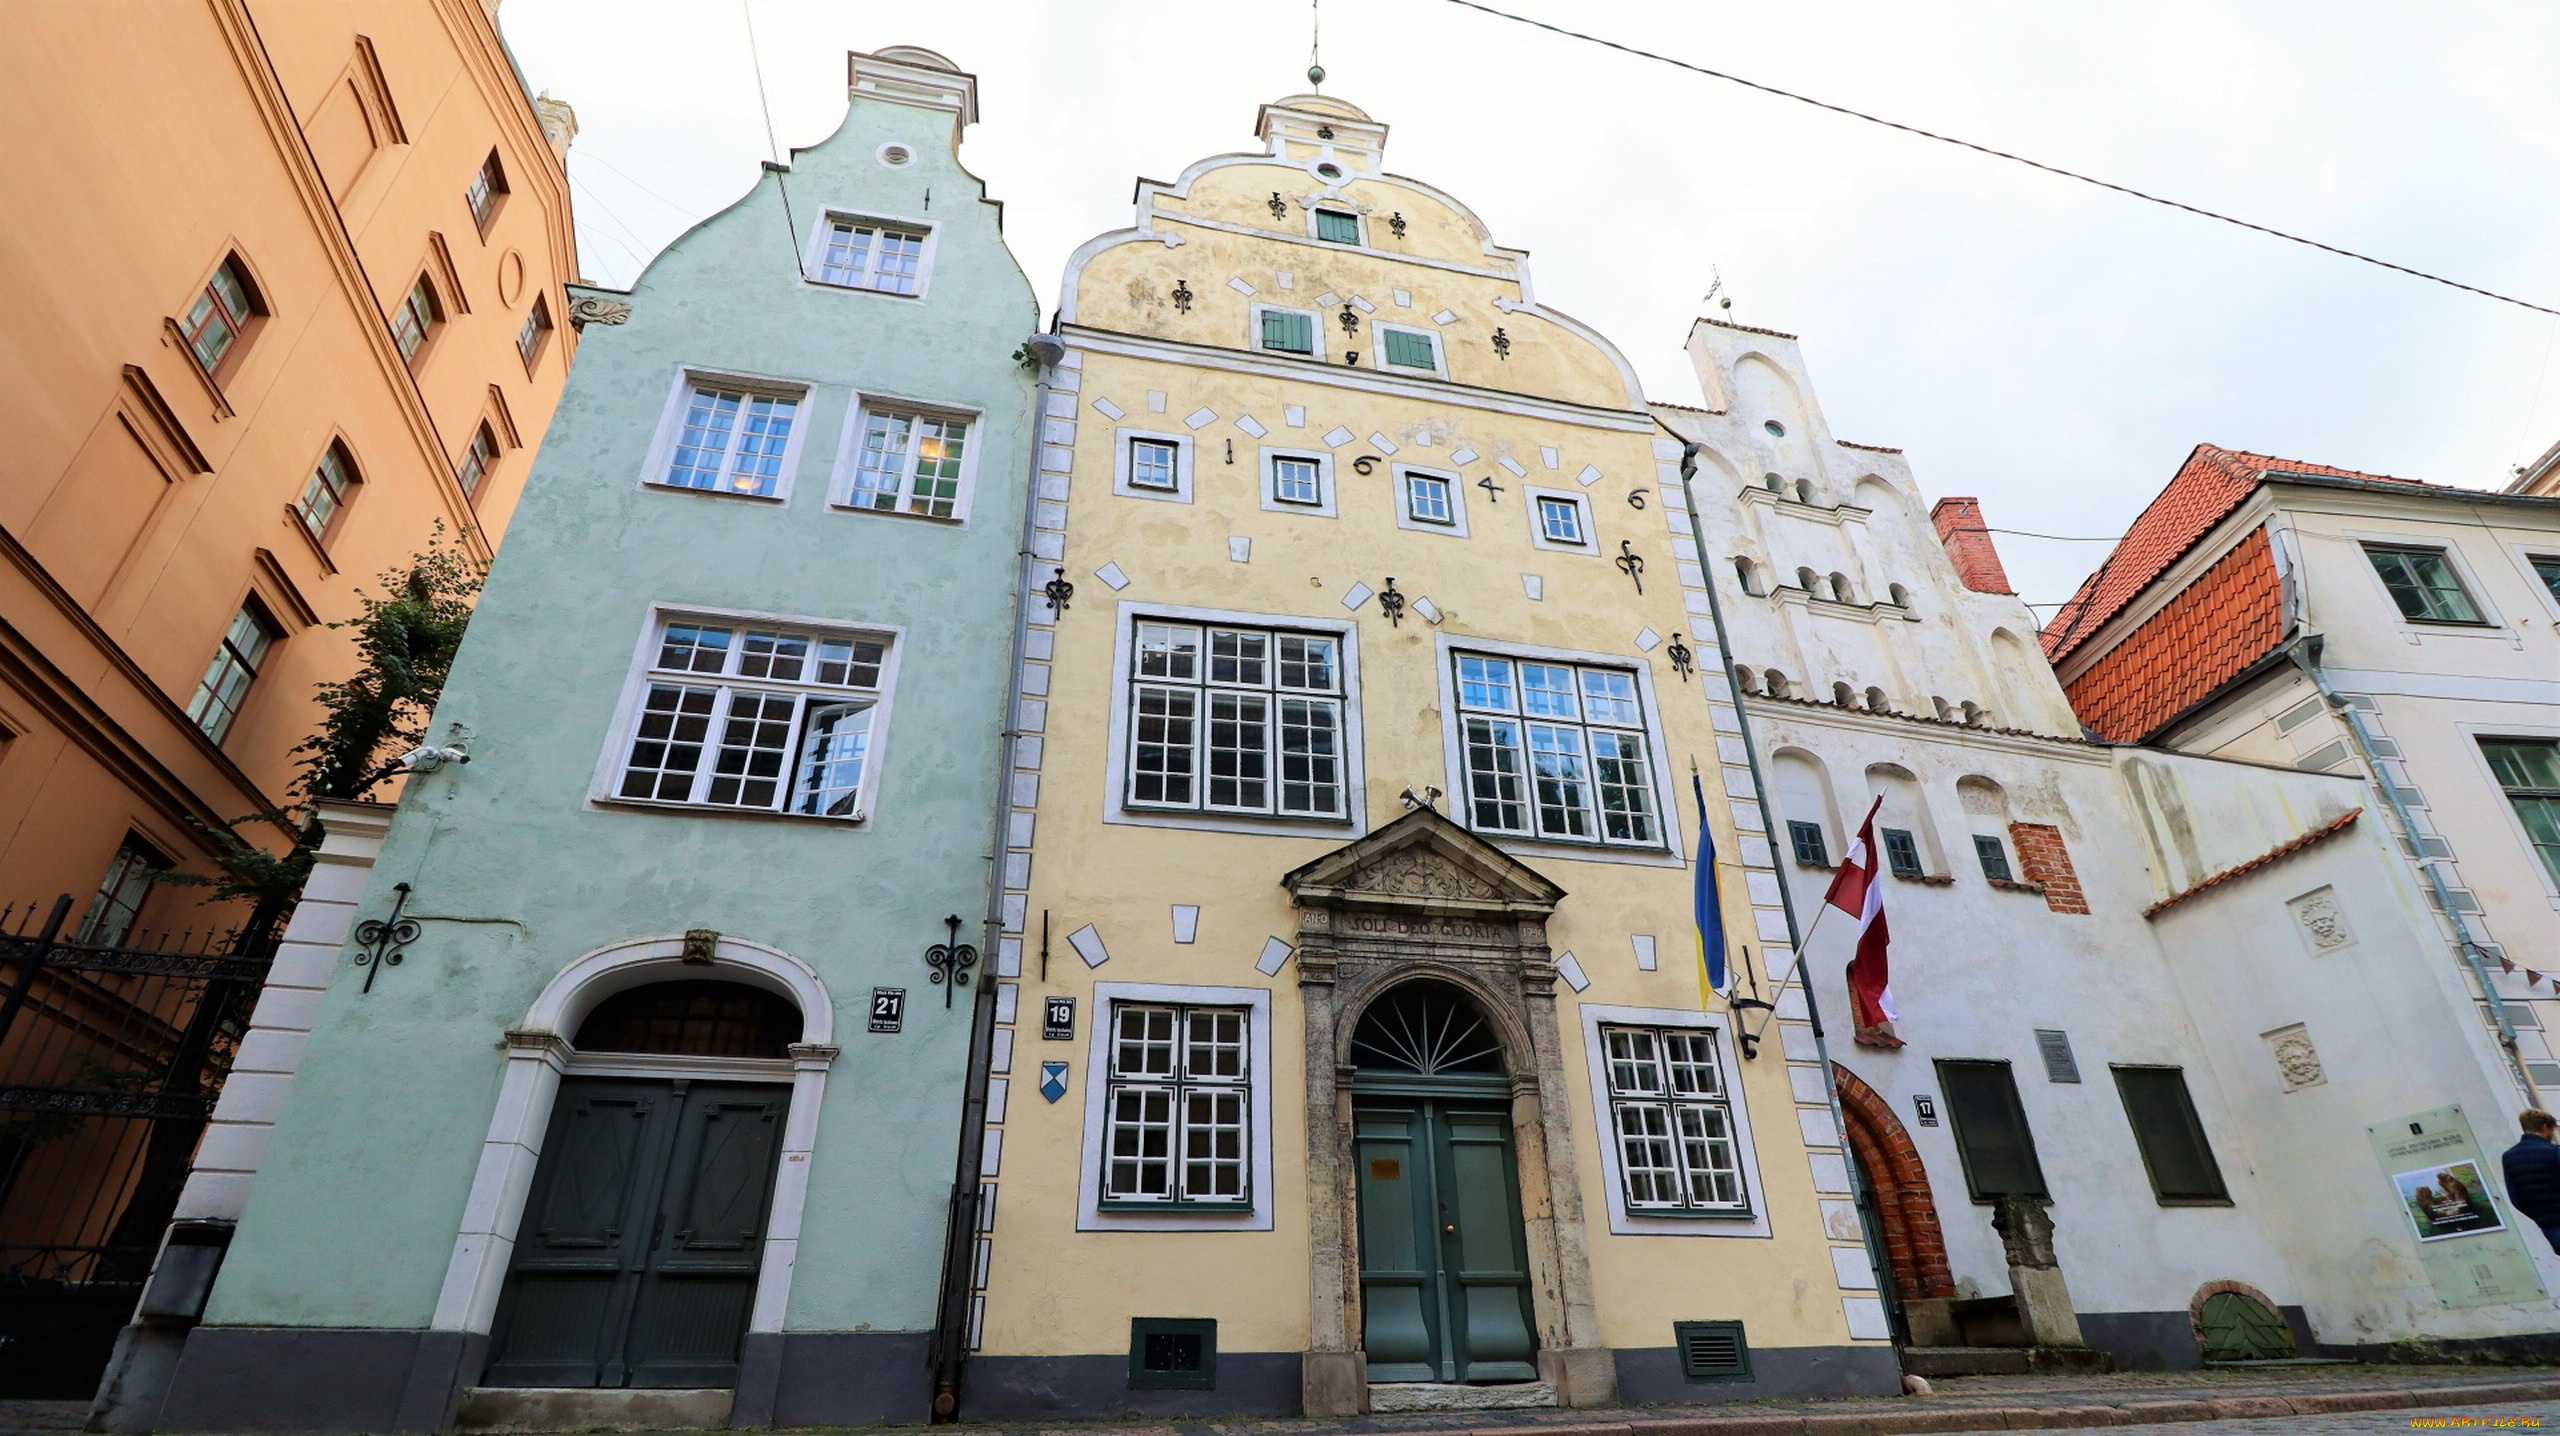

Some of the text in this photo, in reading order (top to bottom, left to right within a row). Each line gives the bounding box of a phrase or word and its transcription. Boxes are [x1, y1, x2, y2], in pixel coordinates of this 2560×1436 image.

[1347, 918, 1501, 938] SOLI DEO GLORIA
[875, 997, 898, 1015] 21
[1050, 1005, 1070, 1023] 19
[1919, 1102, 1931, 1114] 17
